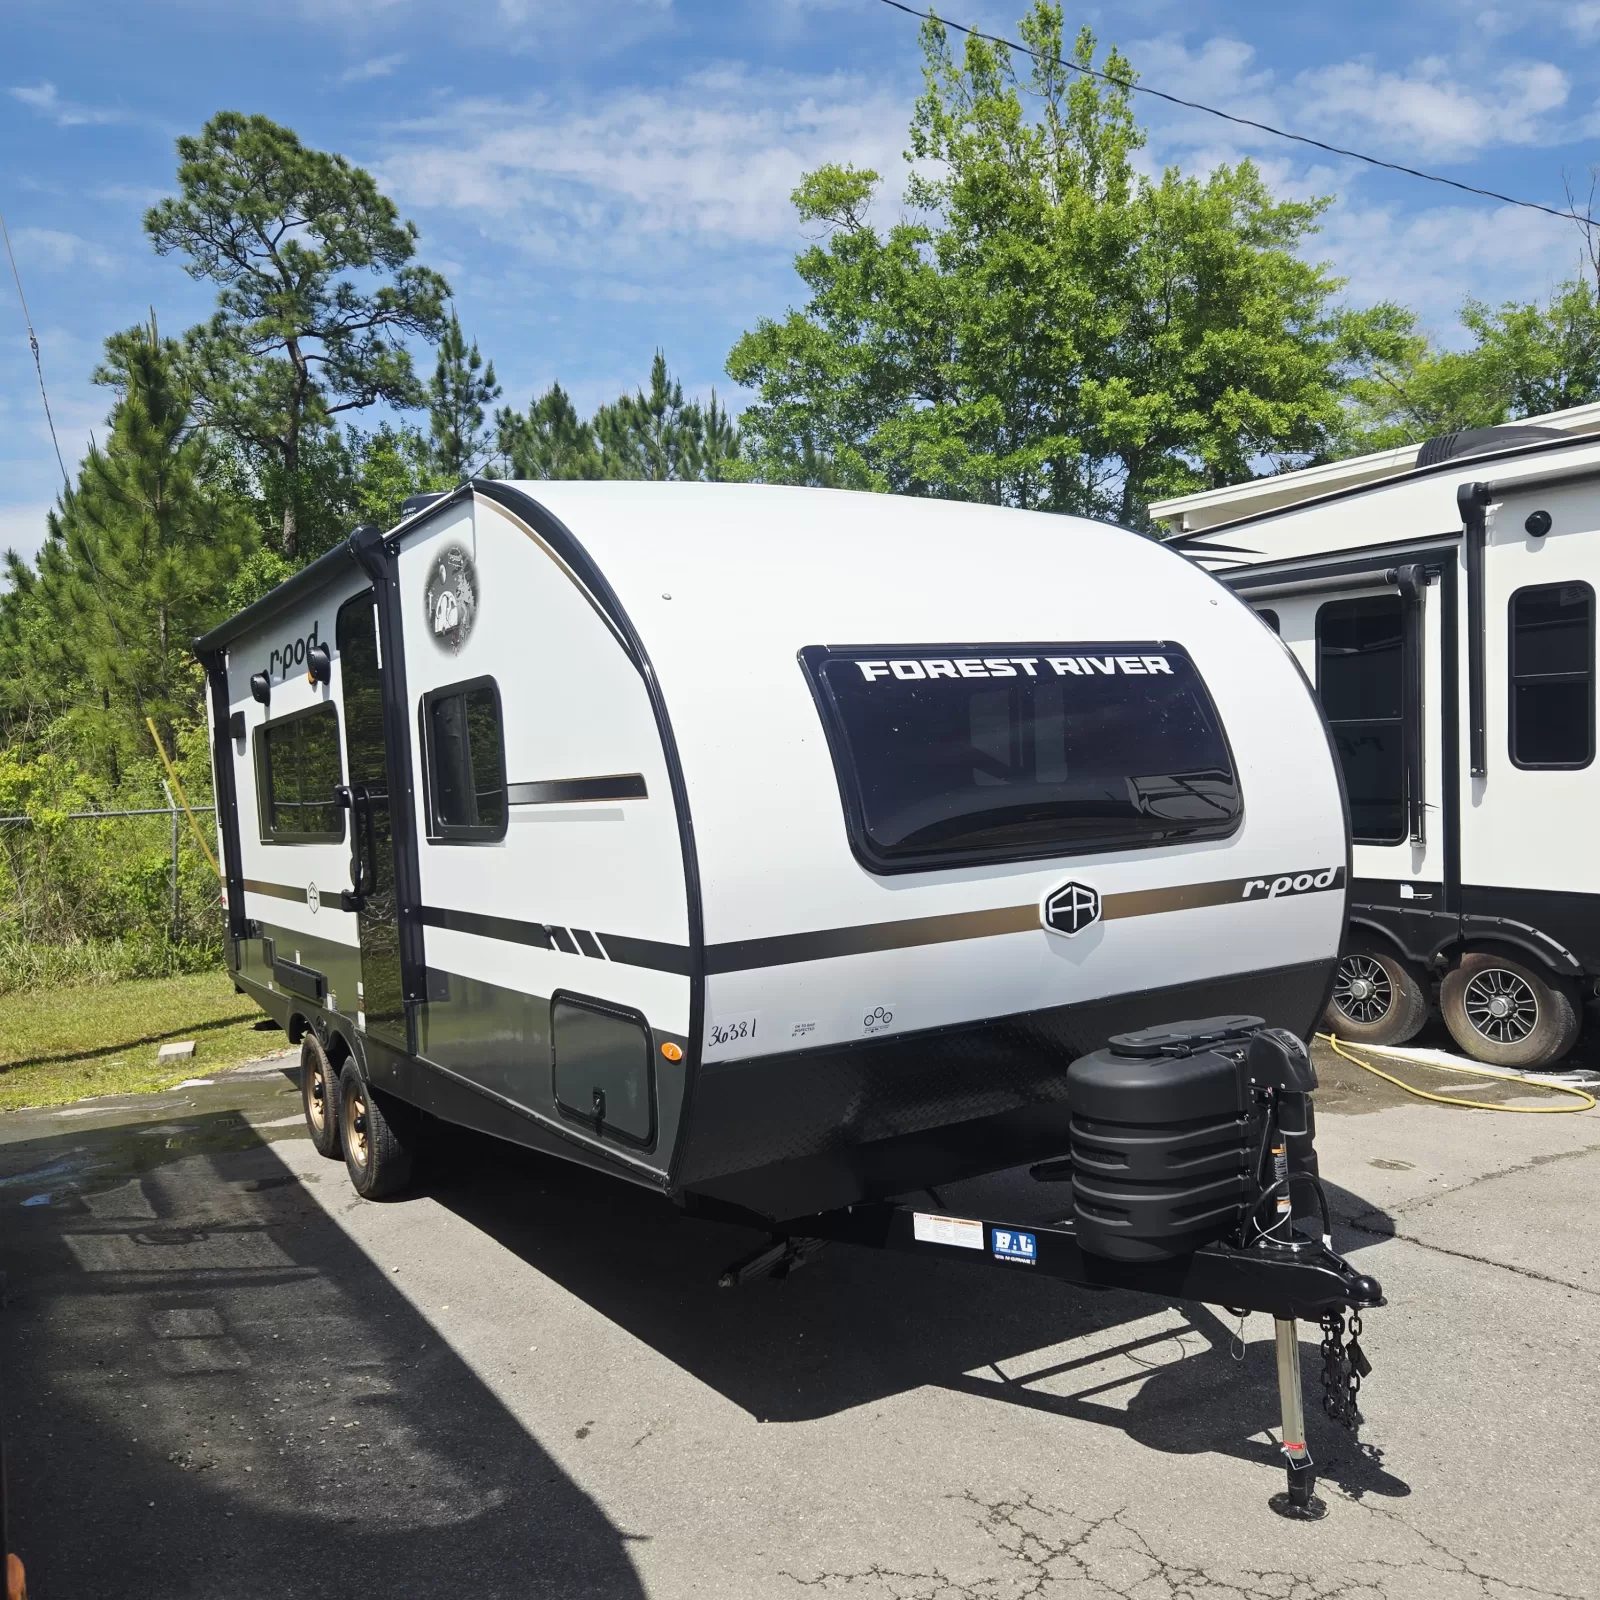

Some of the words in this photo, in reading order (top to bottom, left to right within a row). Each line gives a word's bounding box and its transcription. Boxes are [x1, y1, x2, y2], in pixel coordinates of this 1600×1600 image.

[854, 657, 1039, 682] FOREST
[1044, 655, 1175, 676] RIVER
[708, 1017, 756, 1047] 36381
